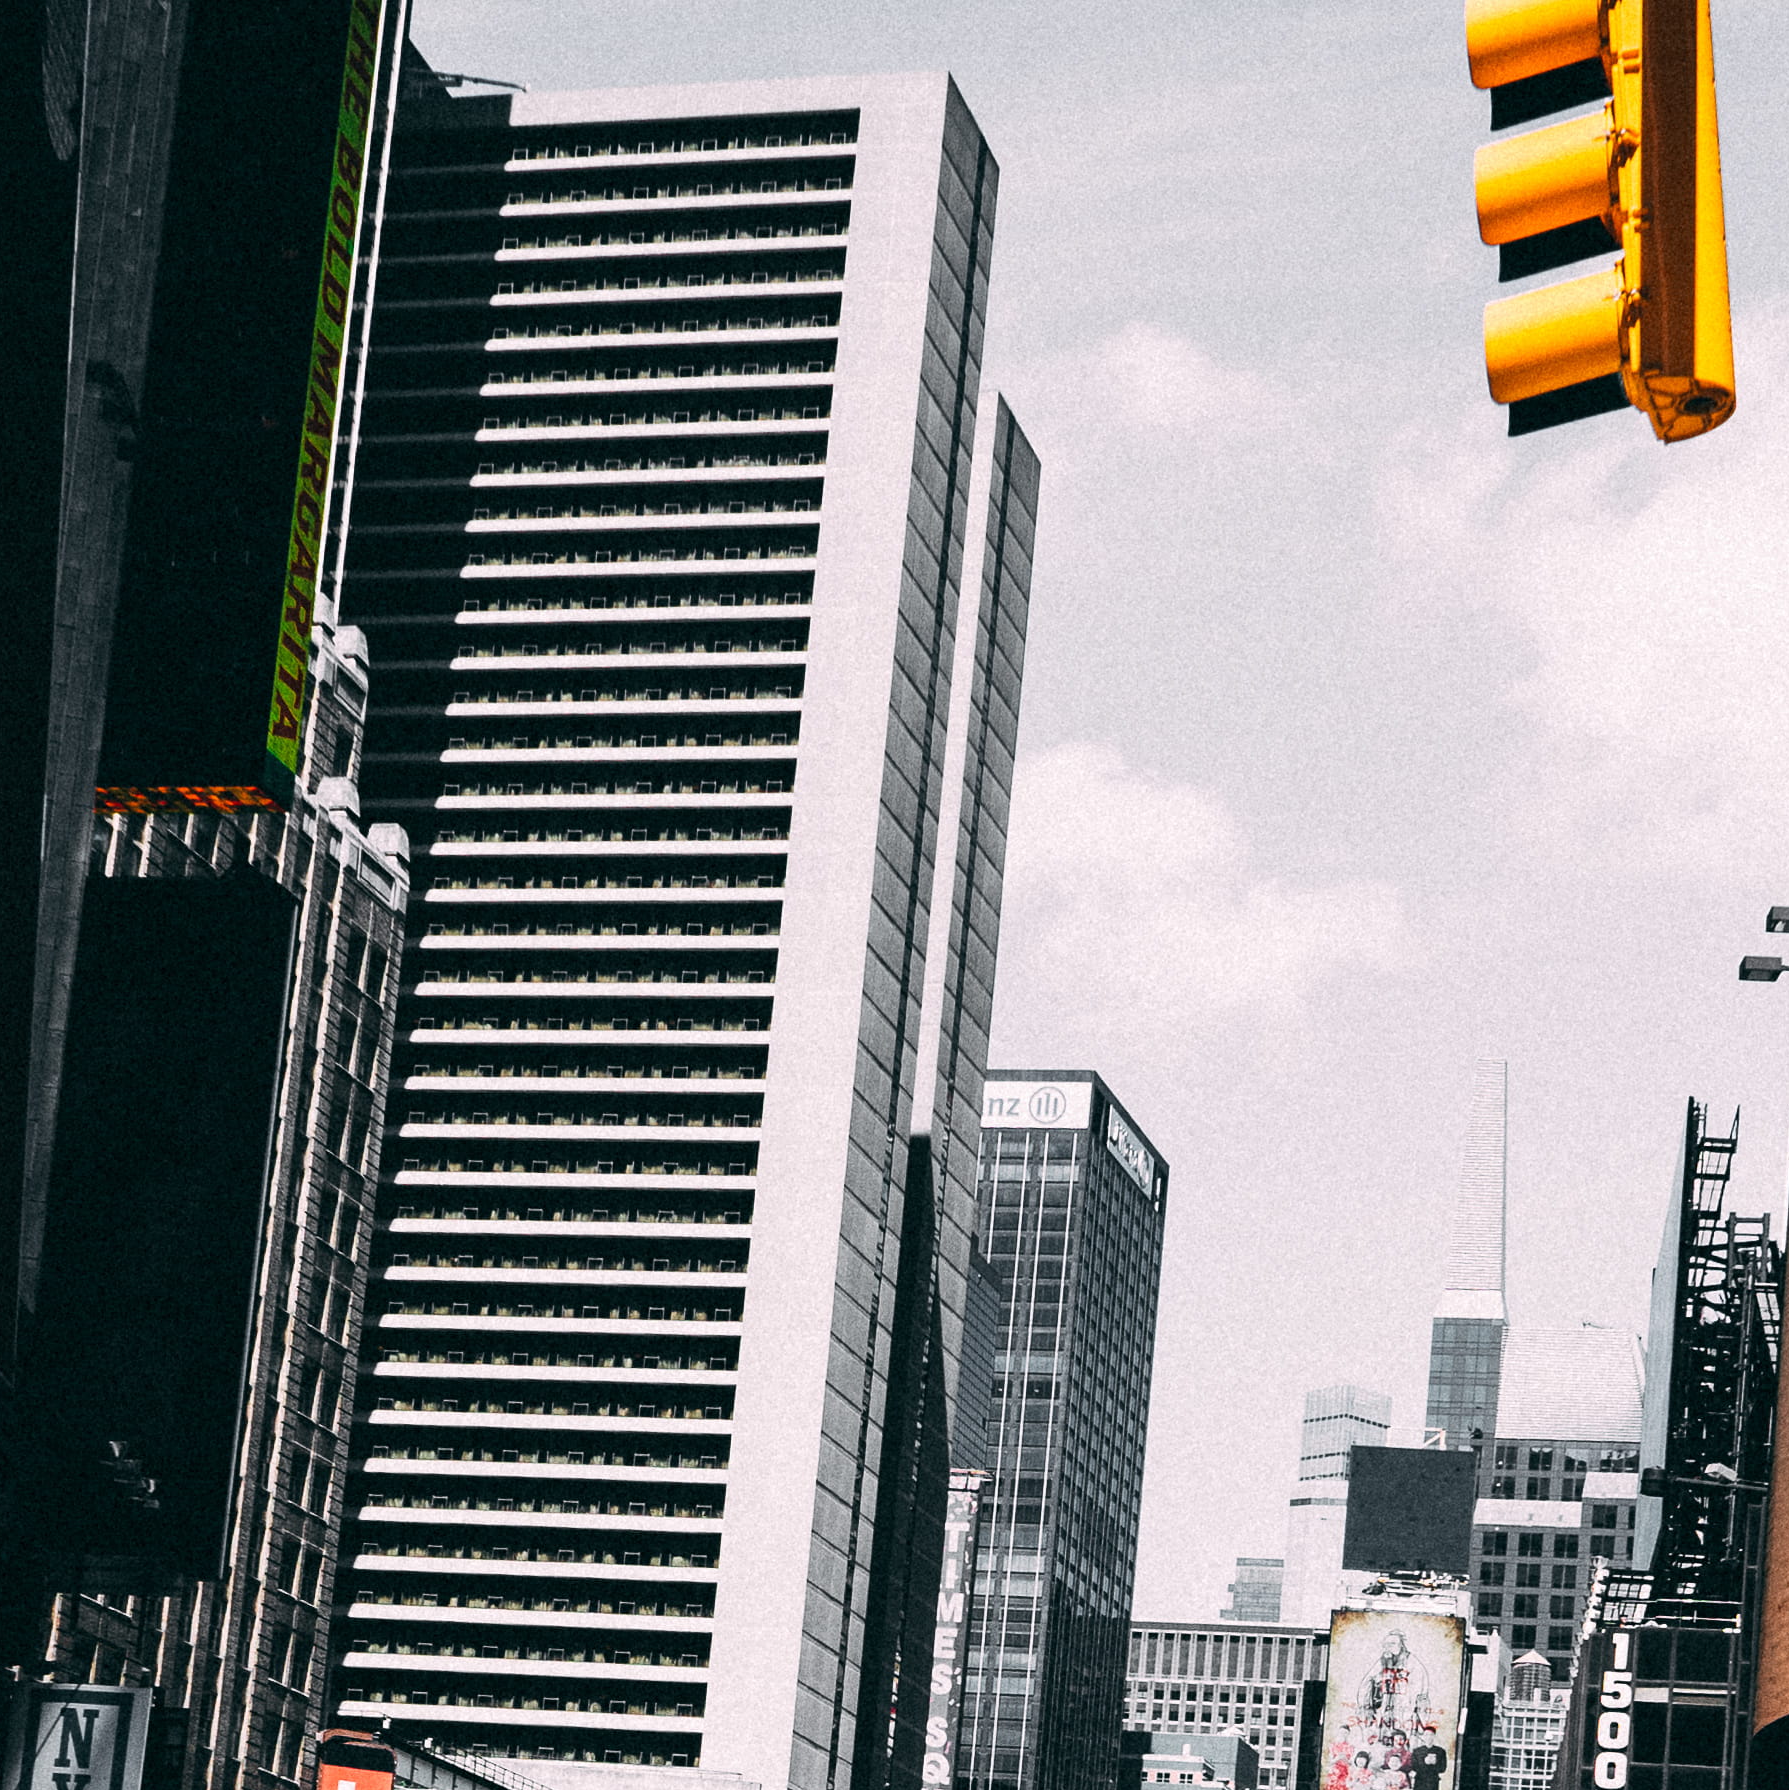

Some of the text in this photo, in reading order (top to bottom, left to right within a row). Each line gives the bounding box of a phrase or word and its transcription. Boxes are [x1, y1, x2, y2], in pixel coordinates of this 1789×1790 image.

[321, 129, 364, 329] BOLD
[272, 330, 342, 742] MARGARITA
[930, 1521, 969, 1696] TIMES
[1594, 1633, 1632, 1789] 1500
